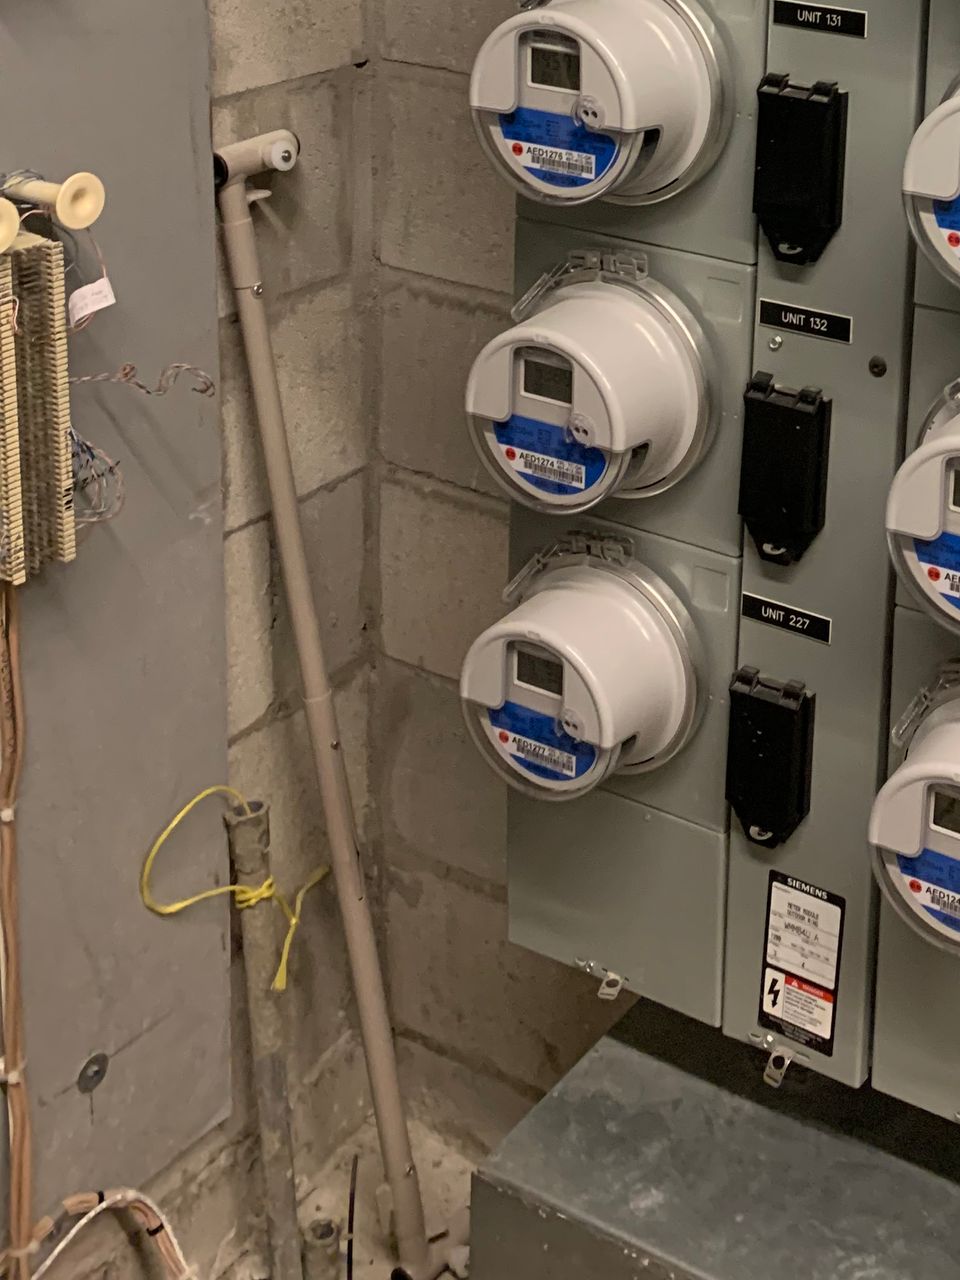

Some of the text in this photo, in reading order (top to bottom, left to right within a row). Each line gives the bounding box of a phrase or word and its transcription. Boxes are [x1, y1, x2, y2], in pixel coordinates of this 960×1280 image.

[798, 10, 842, 26] UNIT 131
[781, 310, 828, 331] UNIT 132
[519, 451, 555, 468] AED1274
[762, 606, 810, 630] UNIT 227
[512, 737, 546, 754] AED1277
[787, 877, 828, 900] SIEMENS
